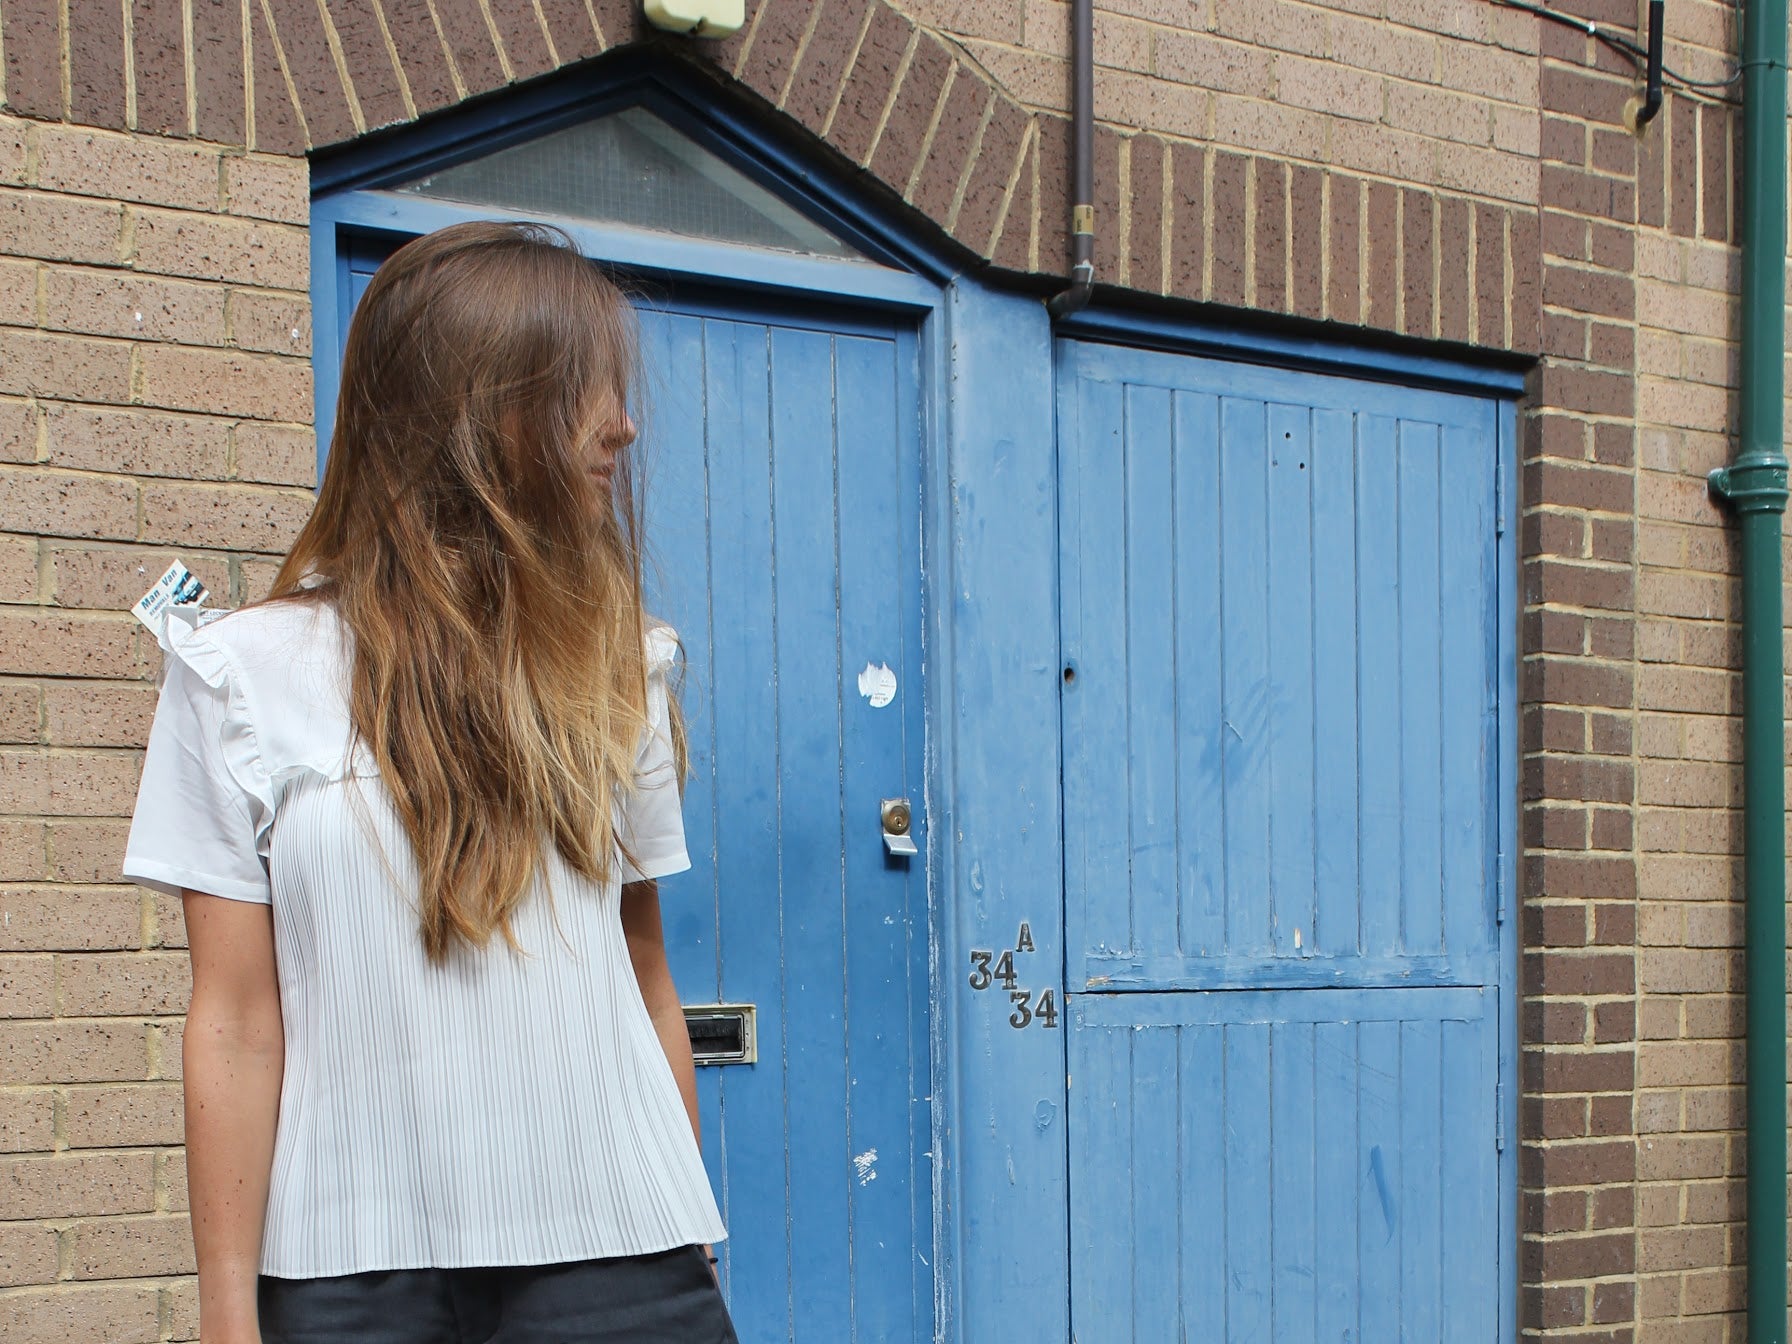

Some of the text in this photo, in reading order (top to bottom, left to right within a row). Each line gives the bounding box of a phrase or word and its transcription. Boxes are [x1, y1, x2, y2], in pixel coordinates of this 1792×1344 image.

[141, 589, 160, 610] Man
[161, 569, 177, 587] Van
[1015, 922, 1035, 952] A
[969, 950, 1018, 990] 34
[1009, 989, 1058, 1029] 34
